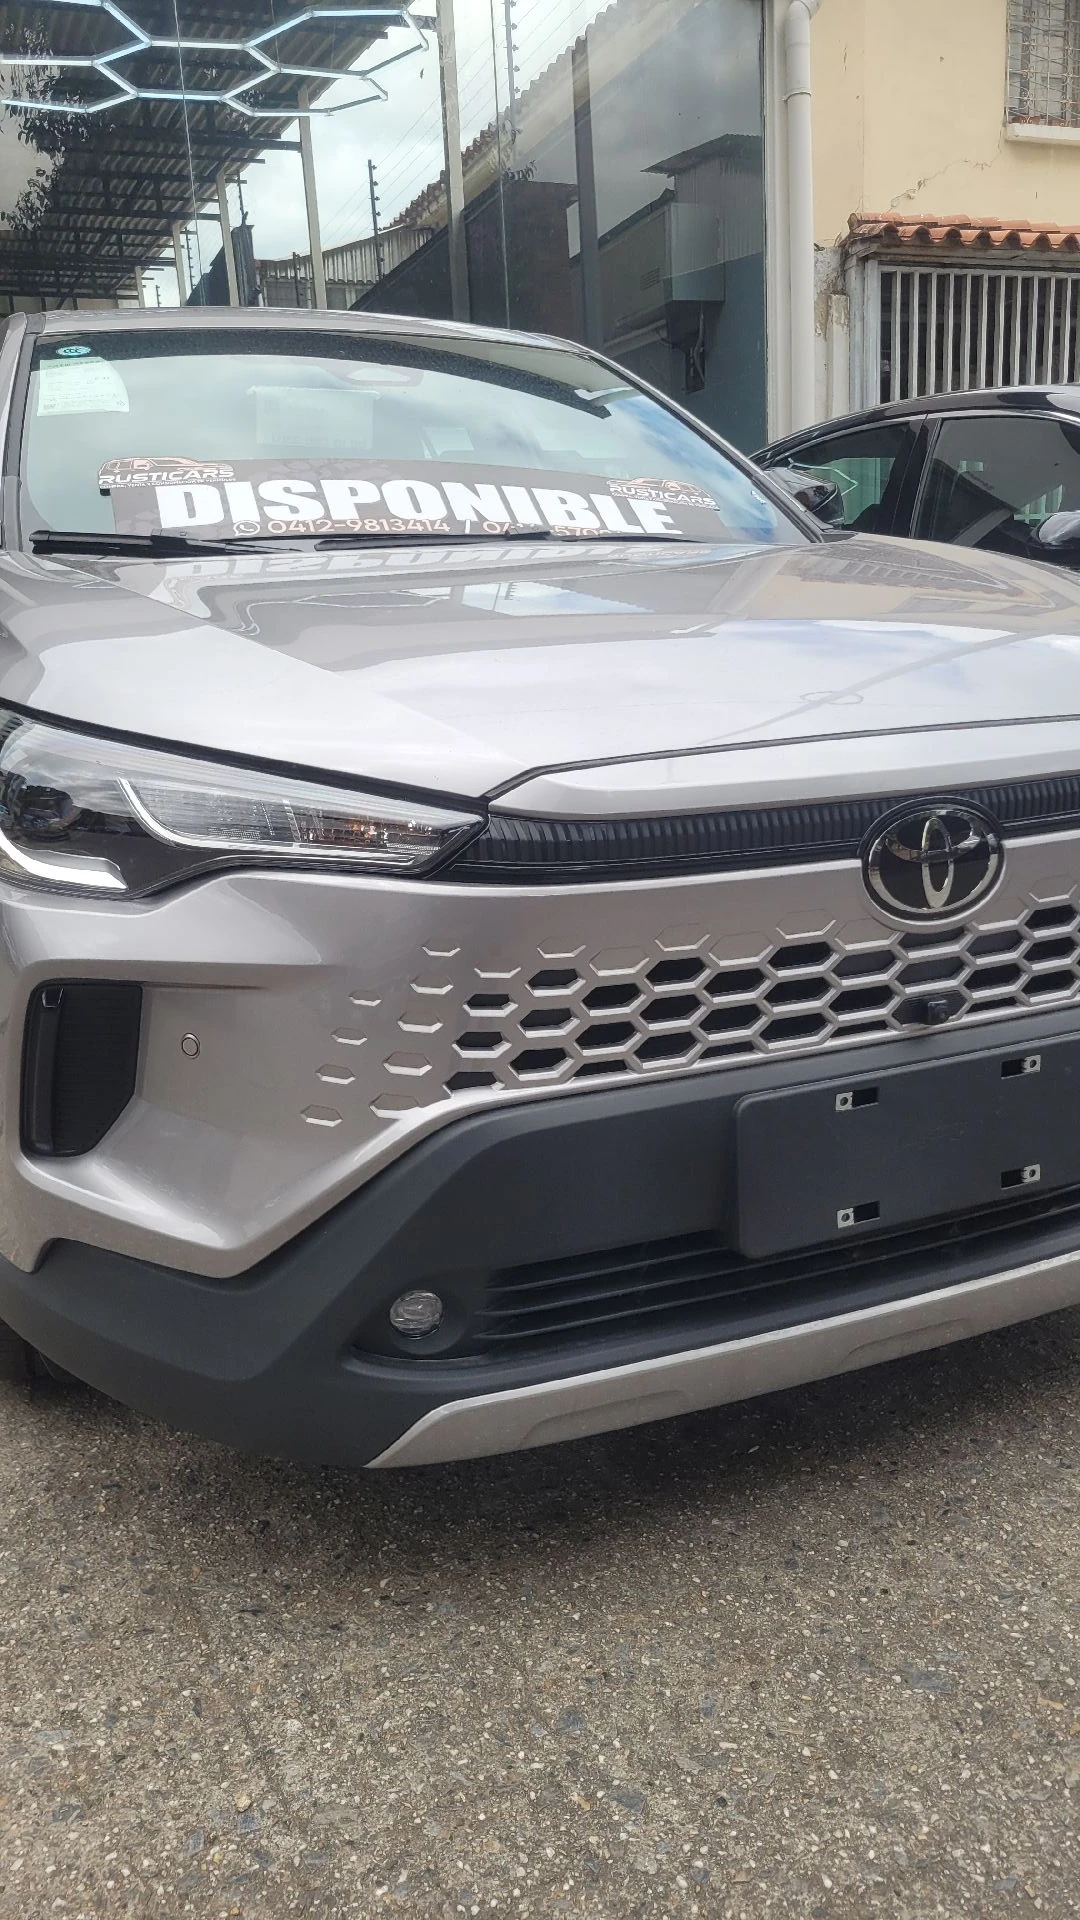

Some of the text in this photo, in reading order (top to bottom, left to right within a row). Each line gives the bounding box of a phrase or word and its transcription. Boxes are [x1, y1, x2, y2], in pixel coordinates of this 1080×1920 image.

[98, 469, 234, 484] RUSTICARS
[609, 485, 717, 506] RUSTICARS
[155, 479, 683, 535] DISPONIBLE
[267, 519, 451, 534] 0412-9813414
